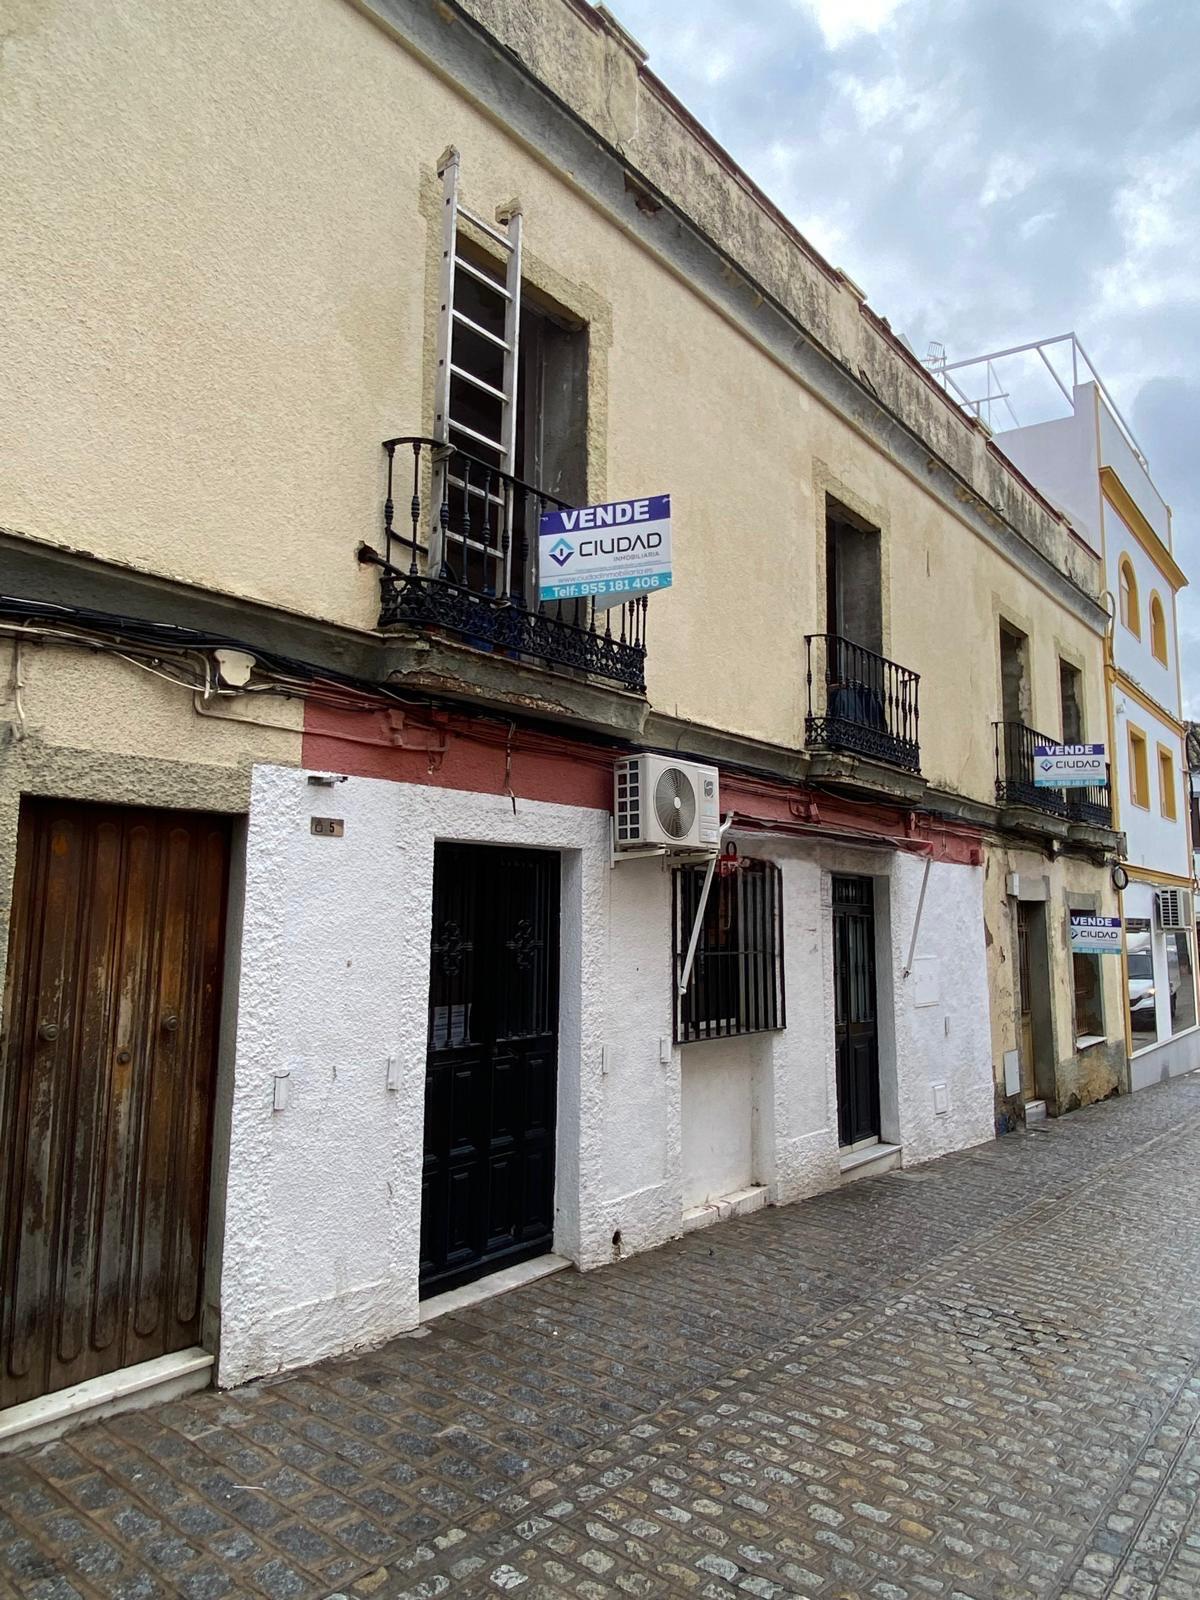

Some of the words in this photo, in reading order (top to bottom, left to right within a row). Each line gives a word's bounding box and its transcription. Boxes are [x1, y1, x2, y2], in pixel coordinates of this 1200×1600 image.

[560, 500, 650, 530] VENDE
[579, 532, 662, 557] CIUDAD
[613, 551, 660, 562] INMOBILIARIA
[552, 586, 579, 598] Telf:
[581, 582, 606, 595] 955
[609, 580, 630, 592] 181
[632, 576, 660, 588] 406
[1045, 745, 1094, 755] VENDE
[1055, 760, 1101, 769] CIUDAD
[1071, 916, 1113, 927] VENDE
[1080, 930, 1118, 939] CIUDAD
